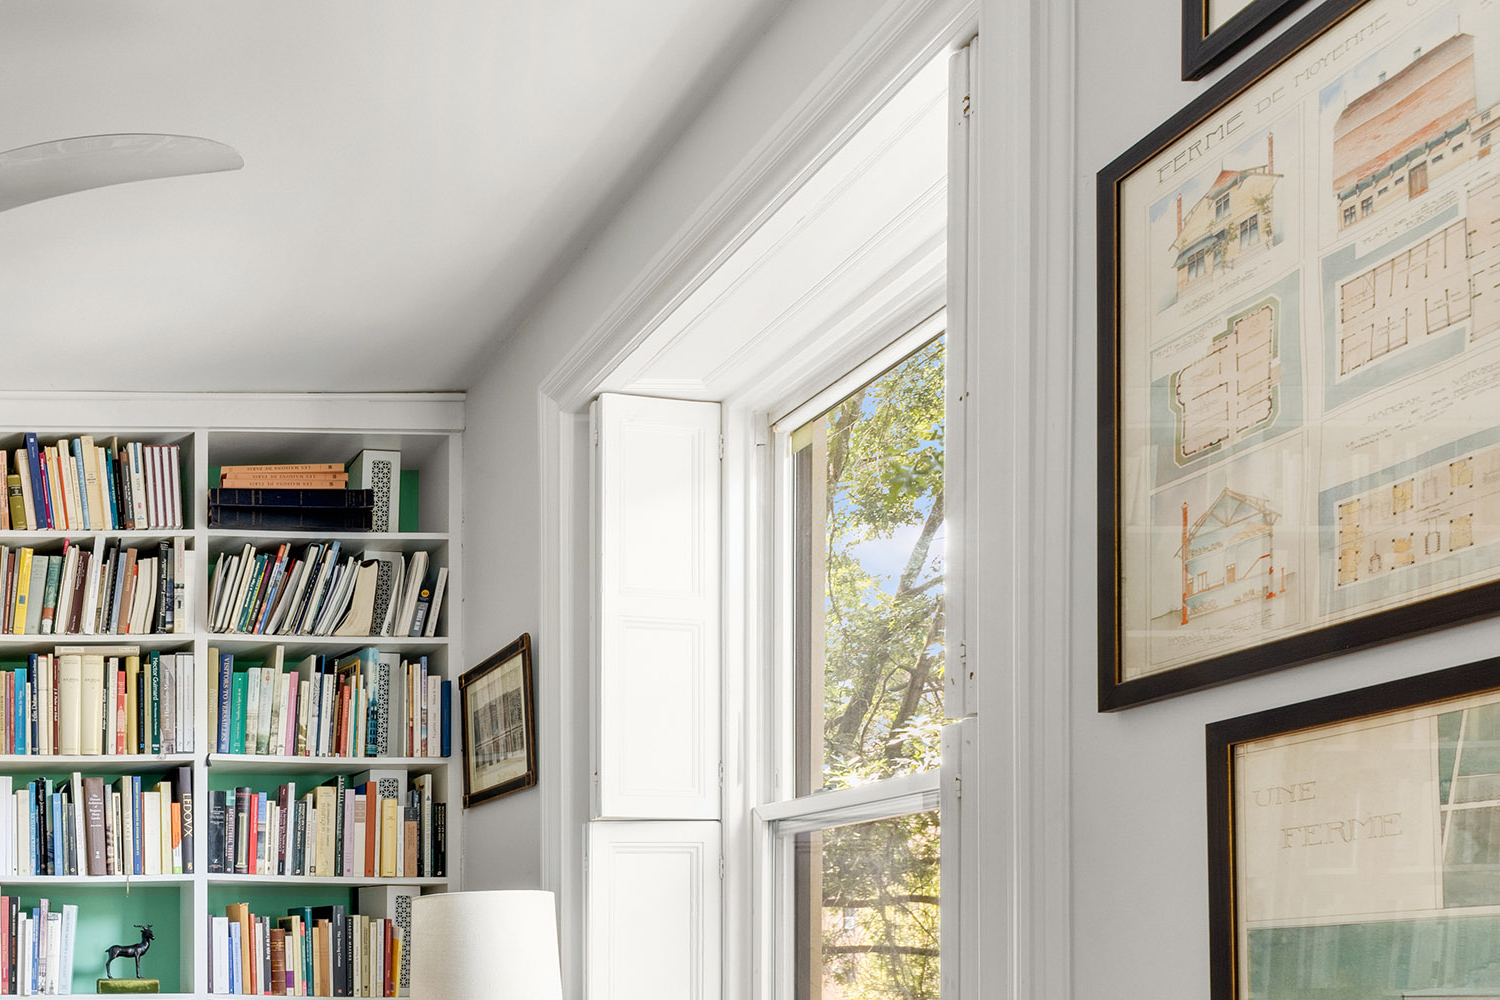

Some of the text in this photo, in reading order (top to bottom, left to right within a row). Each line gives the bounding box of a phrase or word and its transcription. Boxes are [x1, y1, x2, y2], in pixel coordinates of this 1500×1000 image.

[1158, 13, 1389, 182] FERME DE MOYENNE
[223, 690, 229, 698] TO
[1252, 781, 1316, 807] UNE
[1281, 813, 1403, 848] FERME
